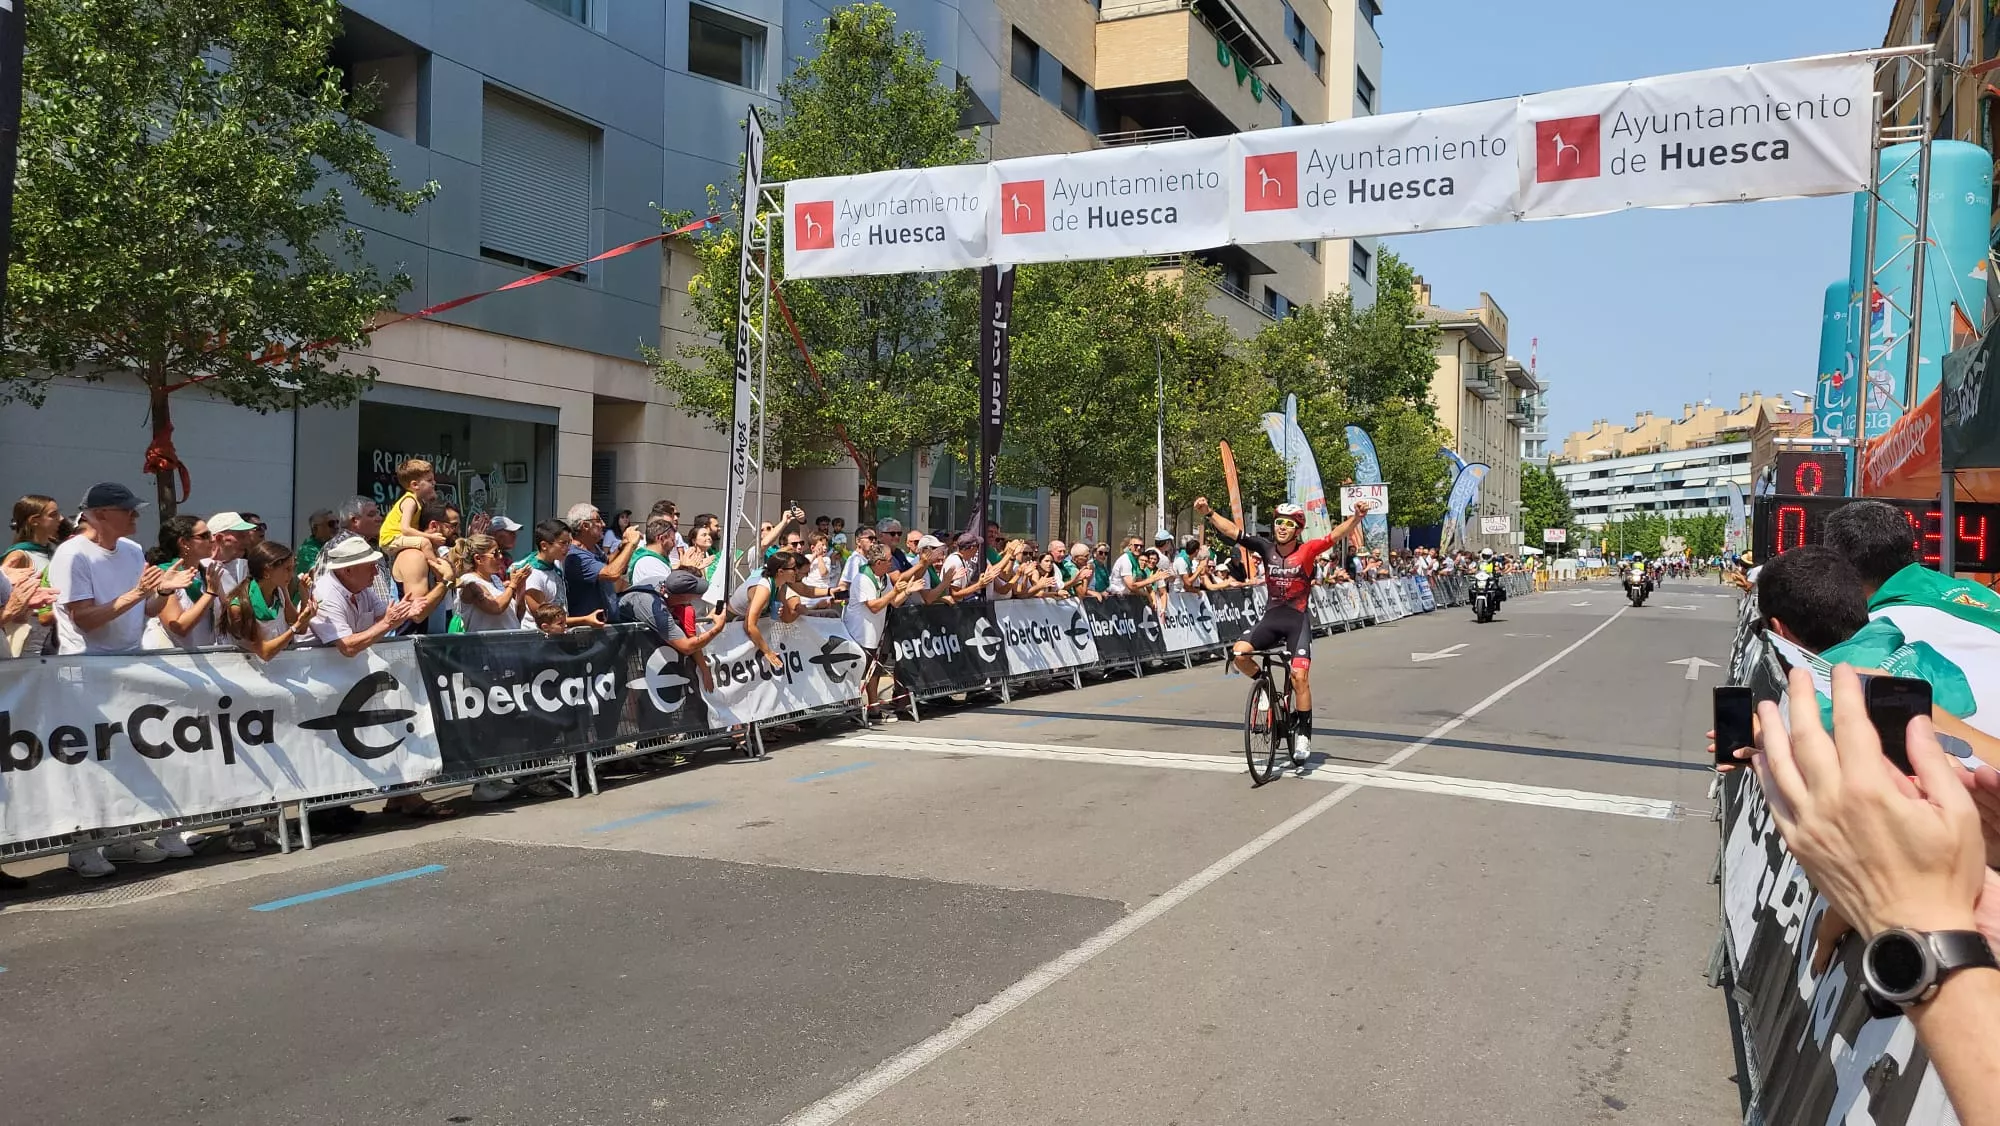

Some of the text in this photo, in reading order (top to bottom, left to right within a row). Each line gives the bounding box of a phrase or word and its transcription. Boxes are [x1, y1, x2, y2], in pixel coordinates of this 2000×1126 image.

[1611, 93, 1851, 144] Ayuntamiento
[1306, 133, 1506, 180] Ayuntamiento
[1611, 138, 1789, 176] de Huesca
[1052, 168, 1219, 206] Ayuntamiento
[1306, 176, 1454, 208] de Huesca
[840, 192, 979, 224] Ayuntamiento
[1052, 205, 1178, 232] de Huesca
[840, 224, 946, 248] de Huesca
[1795, 461, 1822, 496] 0
[894, 625, 961, 663] erCaja
[1005, 618, 1062, 649] iberCaja
[437, 662, 617, 721] iberCaja
[0, 695, 275, 773] berCaja
